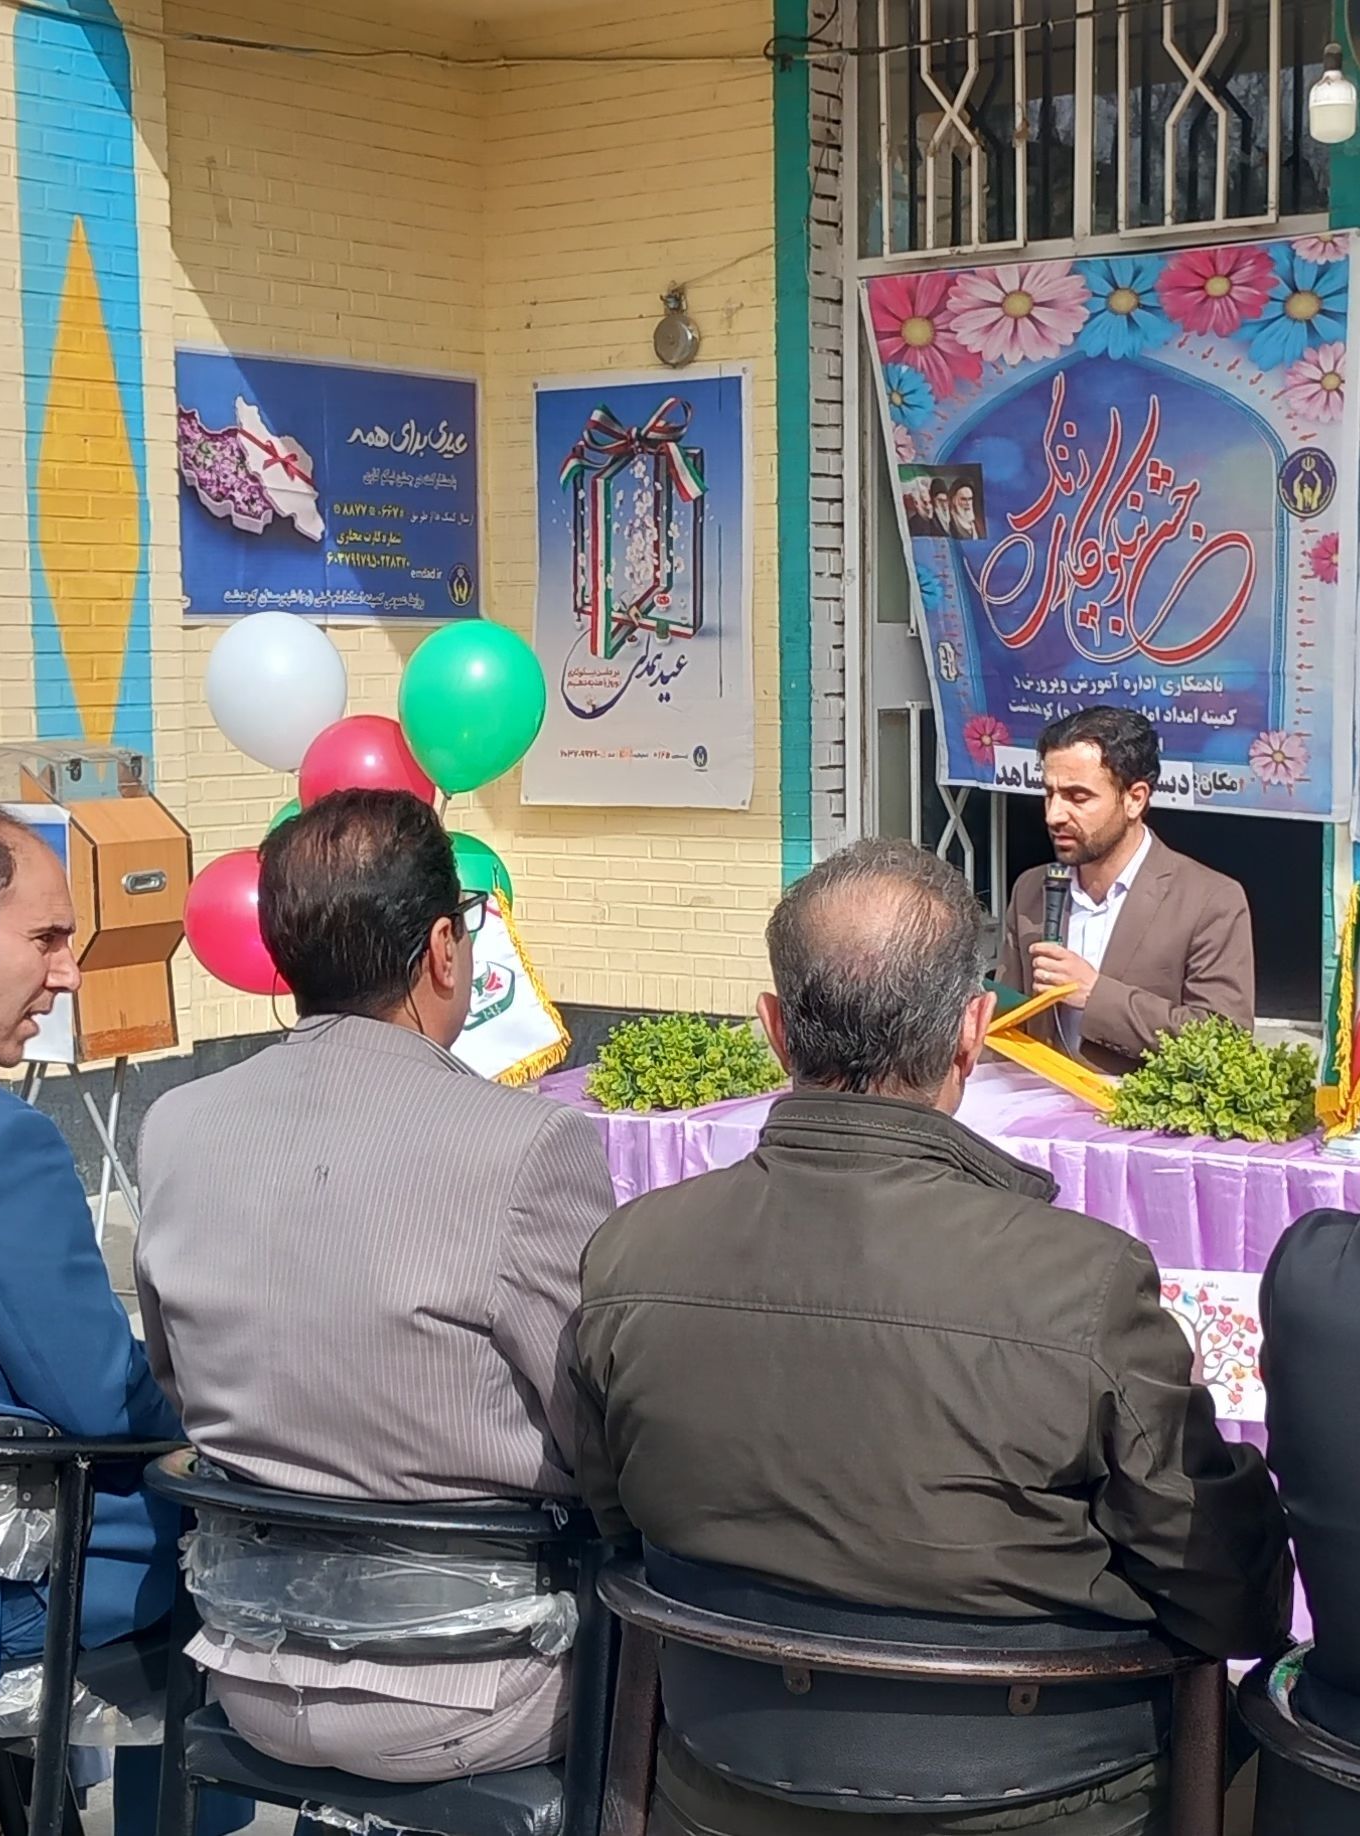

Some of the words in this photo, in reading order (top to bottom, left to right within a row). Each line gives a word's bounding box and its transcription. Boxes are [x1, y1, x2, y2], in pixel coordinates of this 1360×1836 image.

[346, 425, 390, 448] همه
[390, 419, 429, 458] برای
[428, 419, 468, 459] عیدی
[1069, 671, 1118, 695] آموزش
[1122, 675, 1157, 696] اداره
[1163, 707, 1199, 726] امداد
[1201, 708, 1238, 729] کمیته
